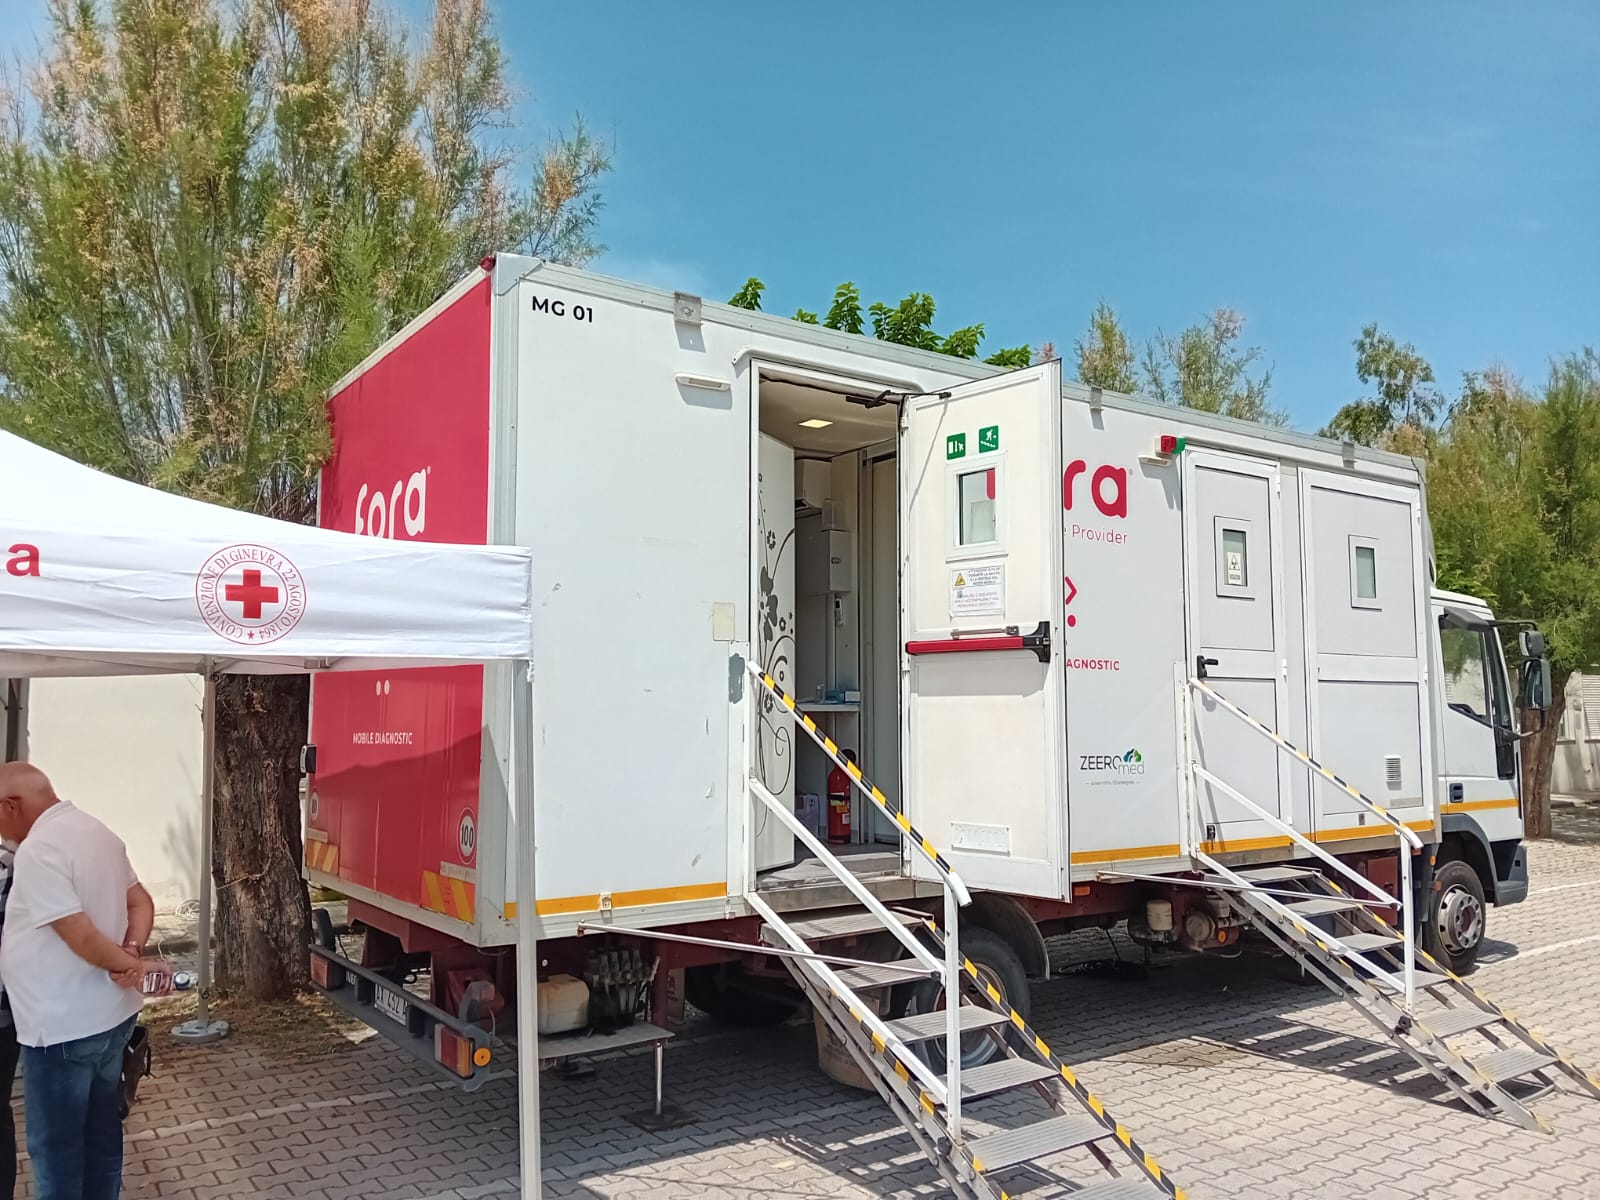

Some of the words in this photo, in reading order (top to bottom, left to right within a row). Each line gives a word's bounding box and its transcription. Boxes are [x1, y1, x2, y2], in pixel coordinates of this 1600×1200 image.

[532, 295, 566, 317] MG
[573, 305, 593, 323] 01
[1072, 523, 1128, 545] Provider
[214, 555, 231, 570] DI
[229, 548, 283, 572] GINEVRA
[281, 567, 297, 582] 22
[201, 565, 243, 639] CONVENZIONE
[280, 583, 302, 627] AGOSTO
[258, 621, 282, 640] 1864
[353, 732, 374, 745] MOBILE
[374, 732, 413, 745] DIAGNOSTIC
[461, 823, 474, 849] 100
